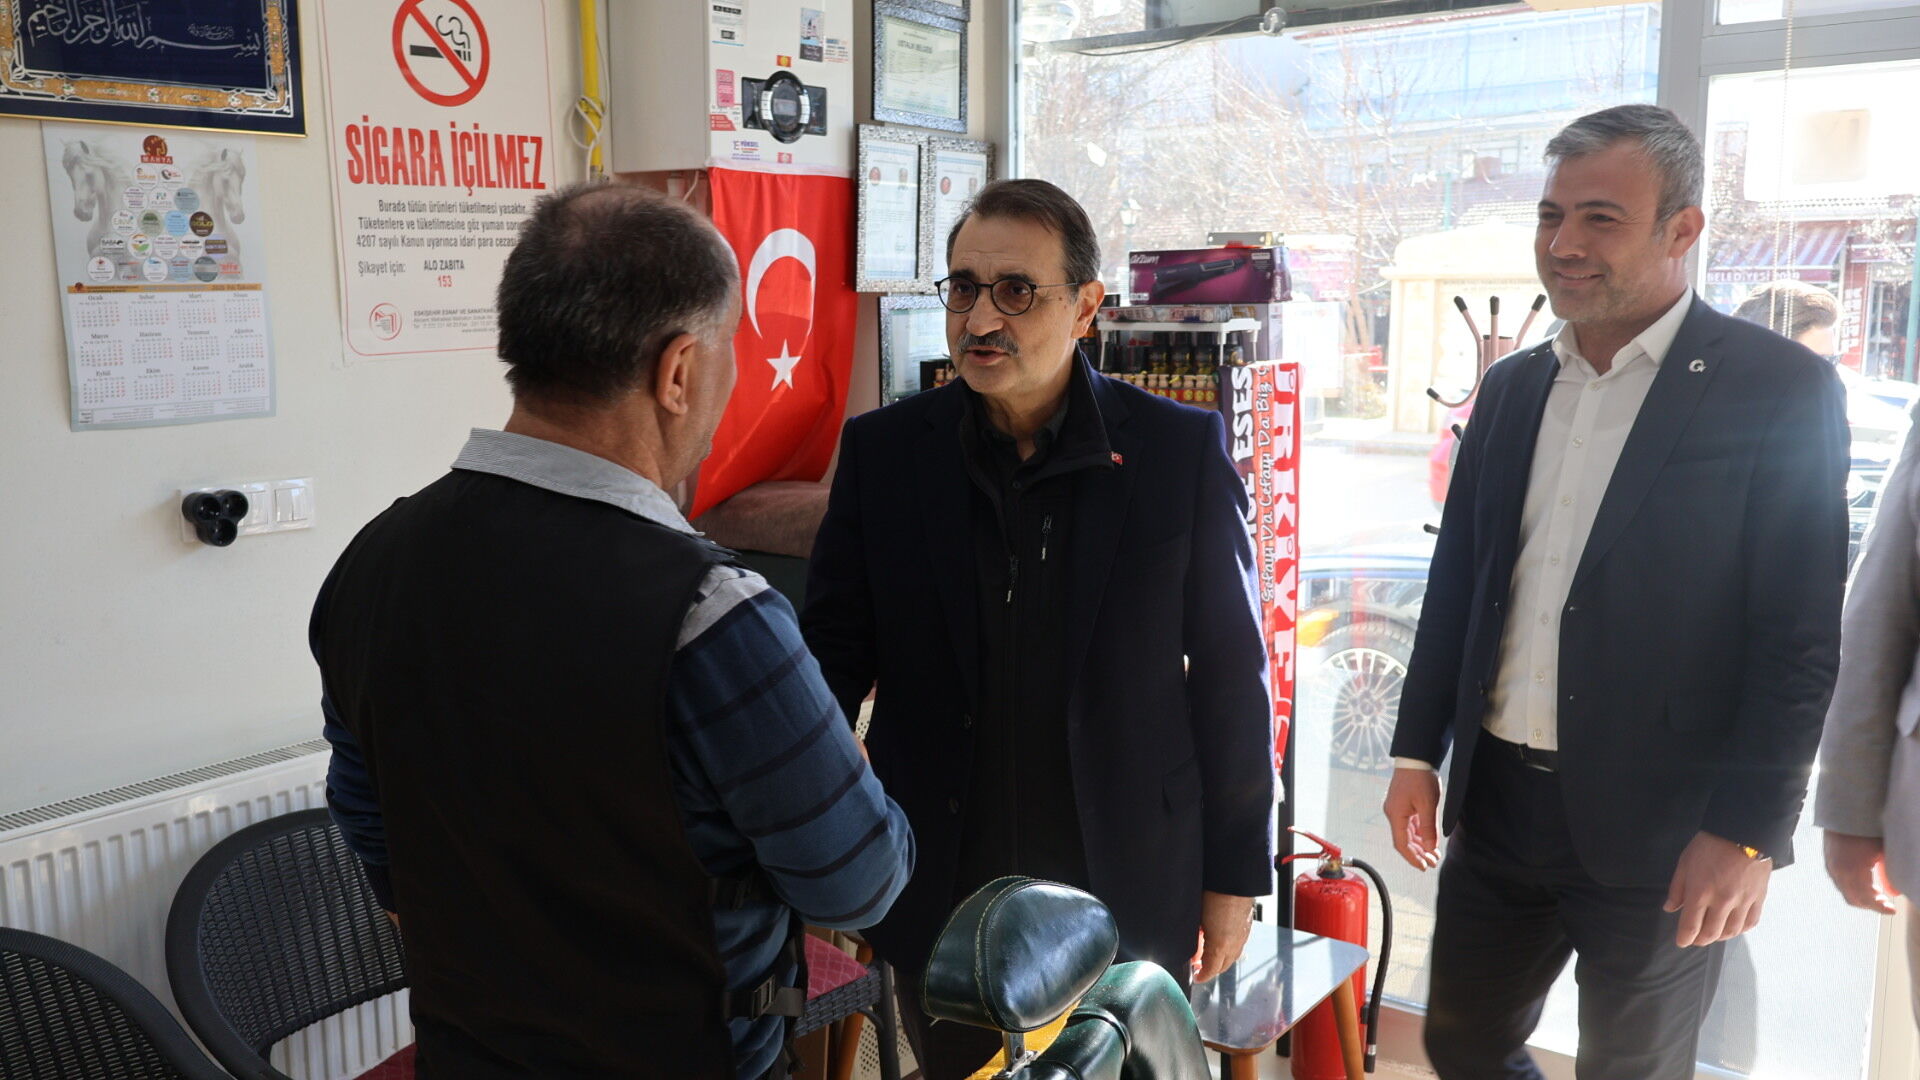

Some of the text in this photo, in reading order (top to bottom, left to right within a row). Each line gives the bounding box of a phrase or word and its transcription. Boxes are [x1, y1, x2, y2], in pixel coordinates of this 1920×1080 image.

[345, 114, 546, 197] SİGARA İÇİLMEZ
[378, 200, 406, 213] Burada
[408, 201, 427, 213] tütün
[429, 201, 457, 214] ürünleri
[459, 202, 498, 215] tüketilmesi
[358, 217, 404, 230] Tüketenlere
[406, 220, 415, 230] ve
[417, 218, 465, 231] tüketilmesine
[467, 219, 479, 233] göz
[482, 221, 504, 233] yuman
[356, 235, 376, 247] 4207
[378, 235, 399, 250] sayılı
[401, 236, 425, 248] Kanun
[427, 236, 457, 249] uyarınca
[459, 236, 476, 247] idari
[478, 237, 493, 249] para
[358, 261, 406, 277] Şikayet için:
[423, 259, 465, 271] ALO ZABITA
[437, 275, 453, 287] 153
[1255, 382, 1272, 412] Biz
[1231, 367, 1254, 463] ESES
[1257, 416, 1271, 447] Da
[1260, 511, 1274, 541] Da
